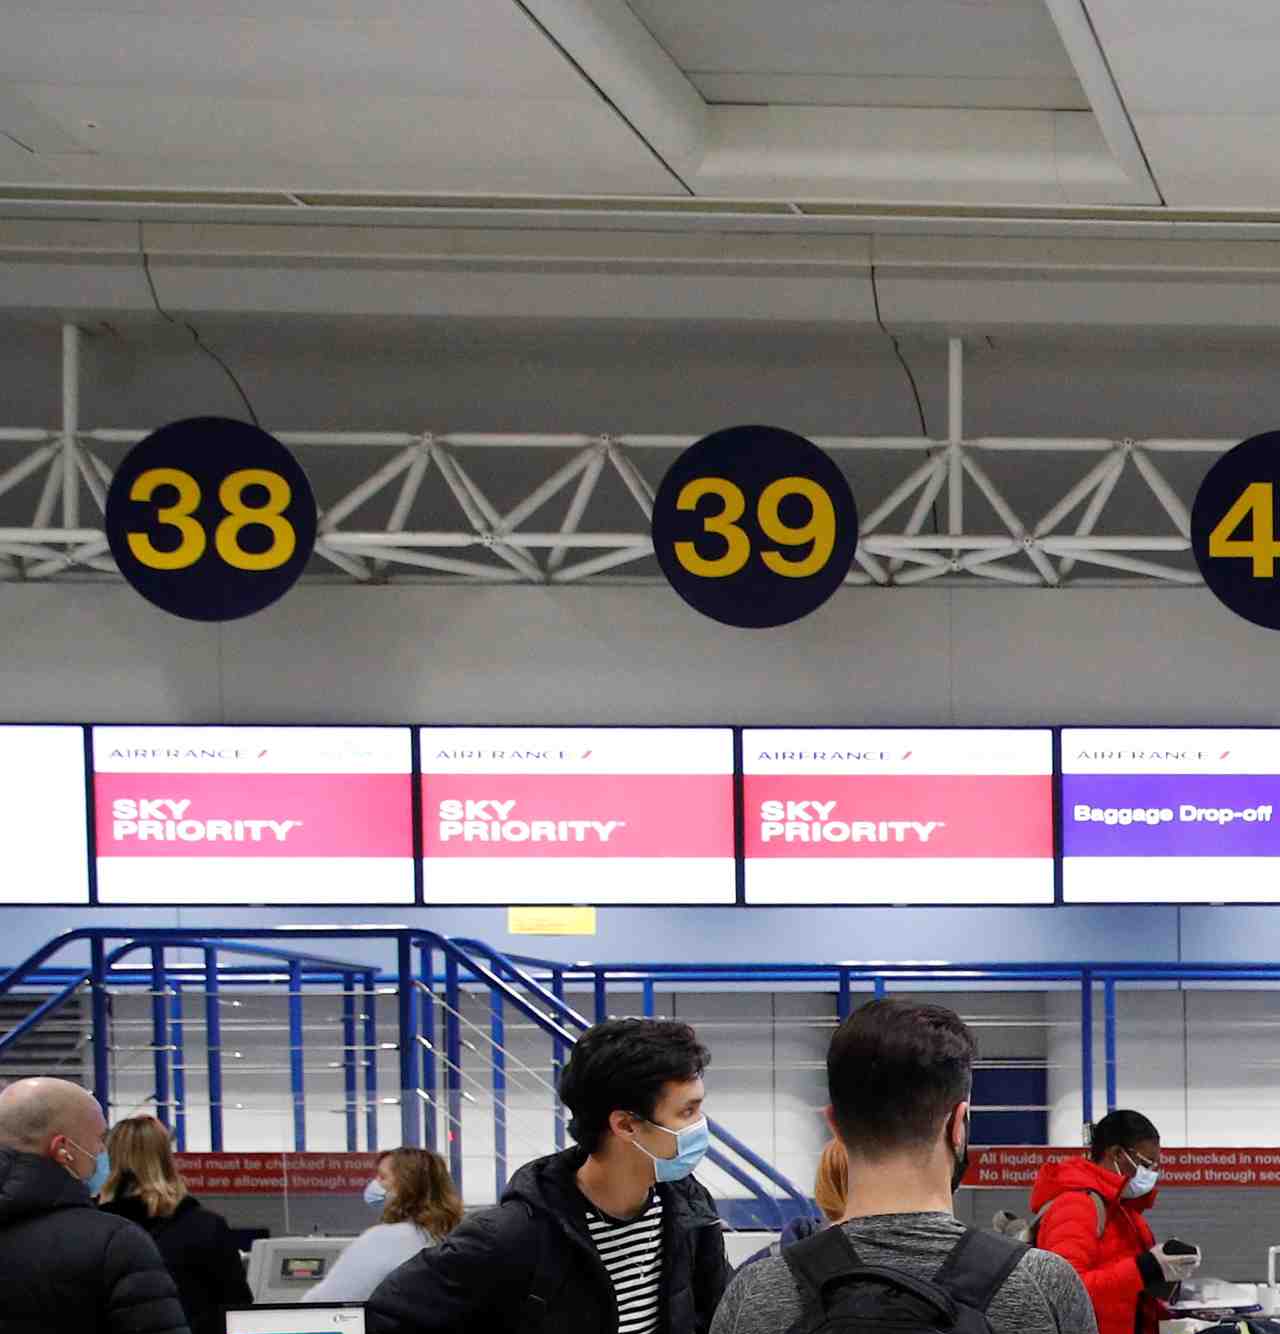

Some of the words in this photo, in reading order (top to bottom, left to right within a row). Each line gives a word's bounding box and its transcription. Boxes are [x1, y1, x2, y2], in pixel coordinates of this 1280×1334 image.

[128, 469, 295, 569] 38
[675, 478, 835, 576] 39
[113, 800, 191, 820] SKY
[439, 800, 516, 820] SKY
[761, 801, 837, 820] SKY
[1073, 805, 1174, 825] Baggage
[1180, 805, 1273, 825] Drop-off
[206, 1158, 241, 1169] must
[244, 1158, 259, 1169] be
[263, 1157, 323, 1169] checked
[329, 1158, 341, 1169] in
[980, 1152, 997, 1164] All
[1000, 1152, 1043, 1167] liquids
[1160, 1153, 1176, 1165] be
[1179, 1153, 1236, 1165] checked
[1240, 1153, 1252, 1165] in
[207, 1177, 231, 1186] are
[233, 1175, 289, 1186] allowed
[292, 1175, 346, 1189] through
[980, 1169, 998, 1181] No
[1002, 1169, 1041, 1183] liquid
[1157, 1169, 1201, 1182] llowed
[1204, 1169, 1256, 1184] through
